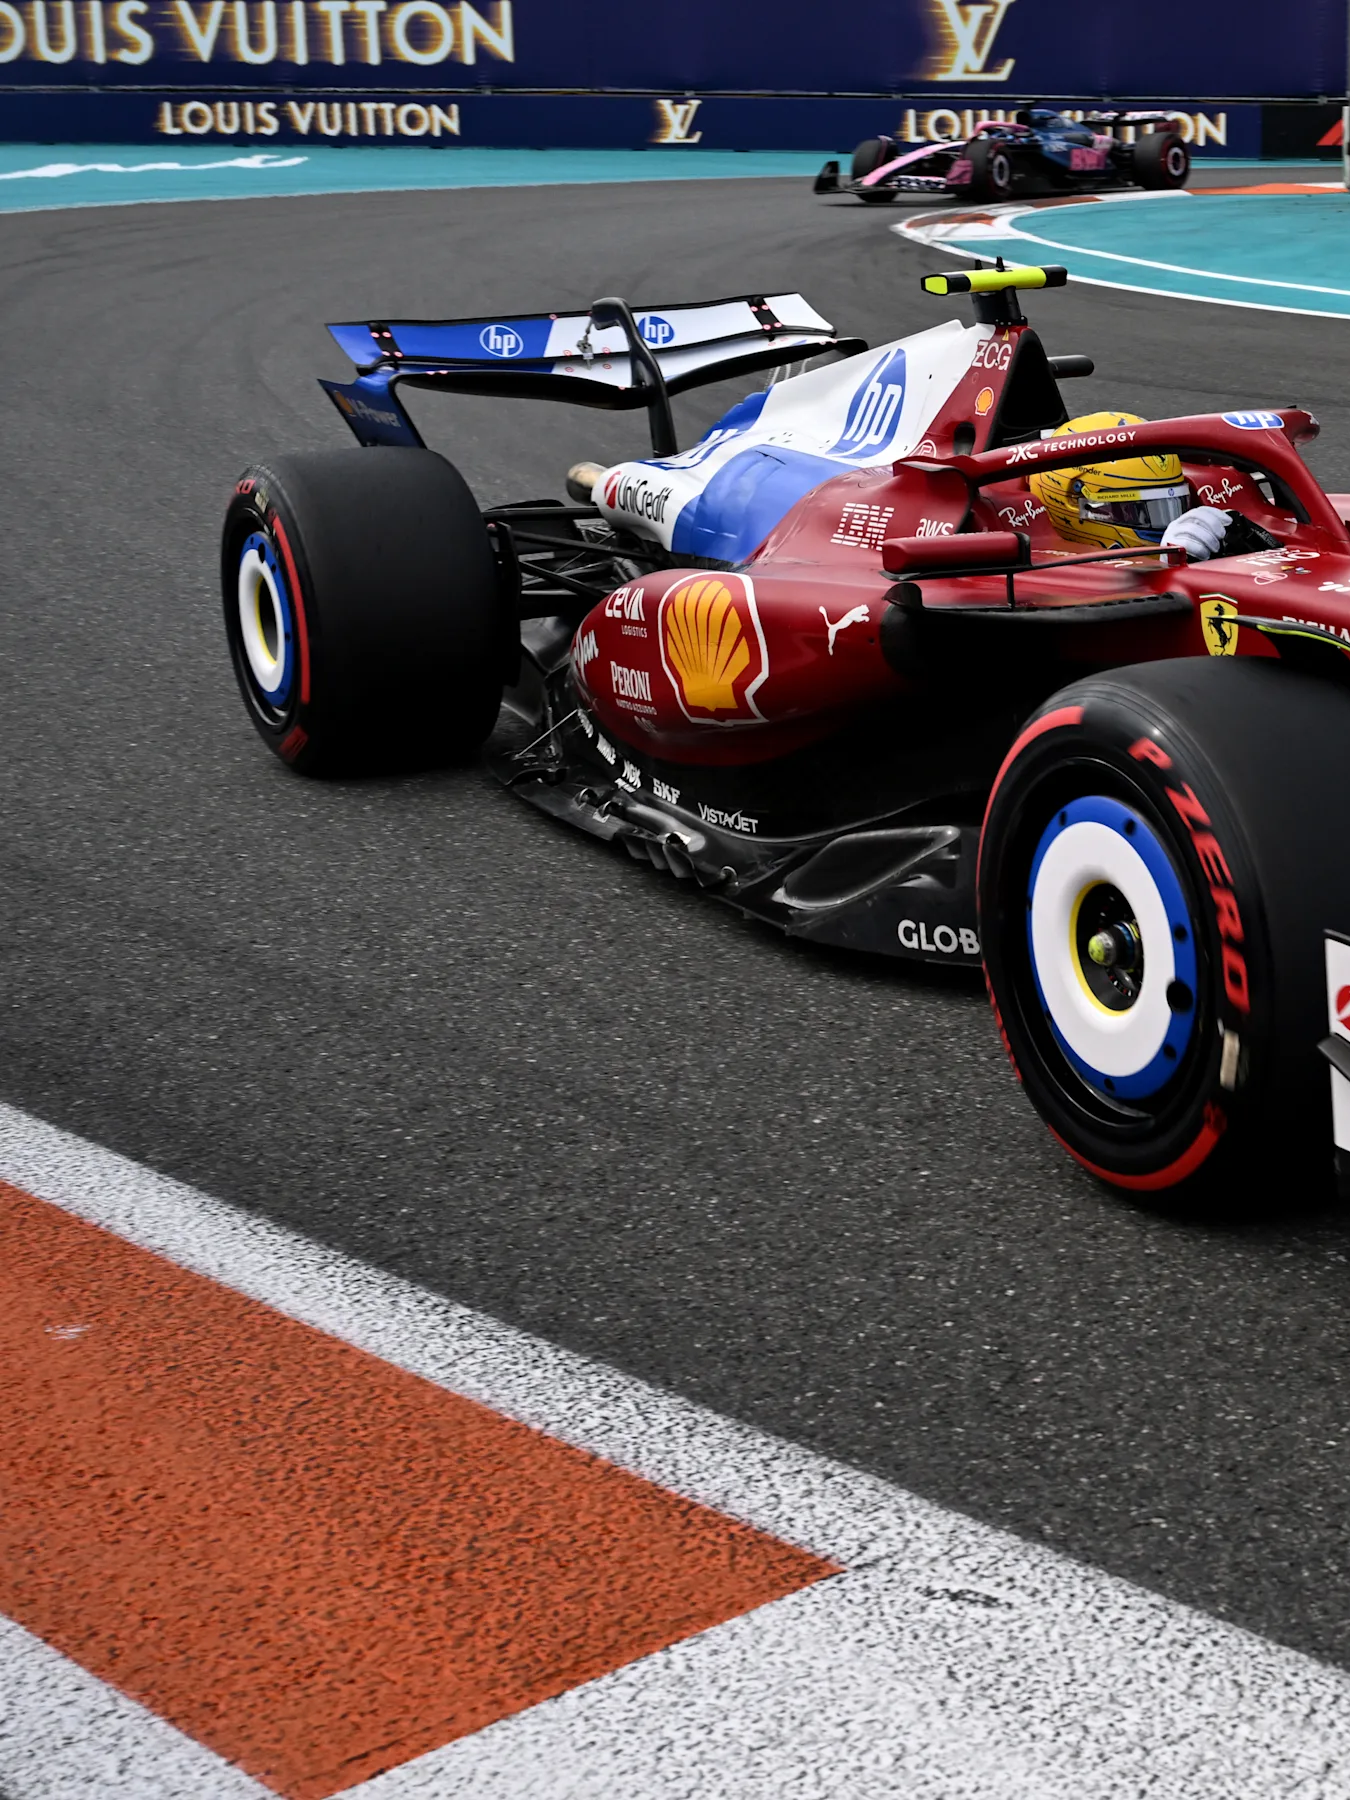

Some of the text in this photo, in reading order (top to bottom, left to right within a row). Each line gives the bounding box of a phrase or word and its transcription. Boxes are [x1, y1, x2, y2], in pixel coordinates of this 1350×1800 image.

[178, 0, 515, 65] VUITTON
[161, 101, 460, 137] LOUIS VUITTON
[488, 326, 517, 358] hp
[642, 316, 670, 345] hp
[972, 340, 1012, 371] ZCG
[1232, 411, 1274, 429] hp
[1005, 431, 1137, 466] DXC TECHNOLOGY
[616, 471, 673, 524] UniCredit
[1197, 477, 1243, 505] Ray-Ban
[830, 502, 895, 551] IBM
[916, 518, 954, 538] aws
[621, 625, 648, 638] LOGISTICS
[610, 661, 653, 702] PERONI
[622, 760, 641, 788] NGK
[652, 777, 680, 805] SKF
[698, 802, 758, 834] VISTAJET
[1165, 781, 1251, 1014] ZERO
